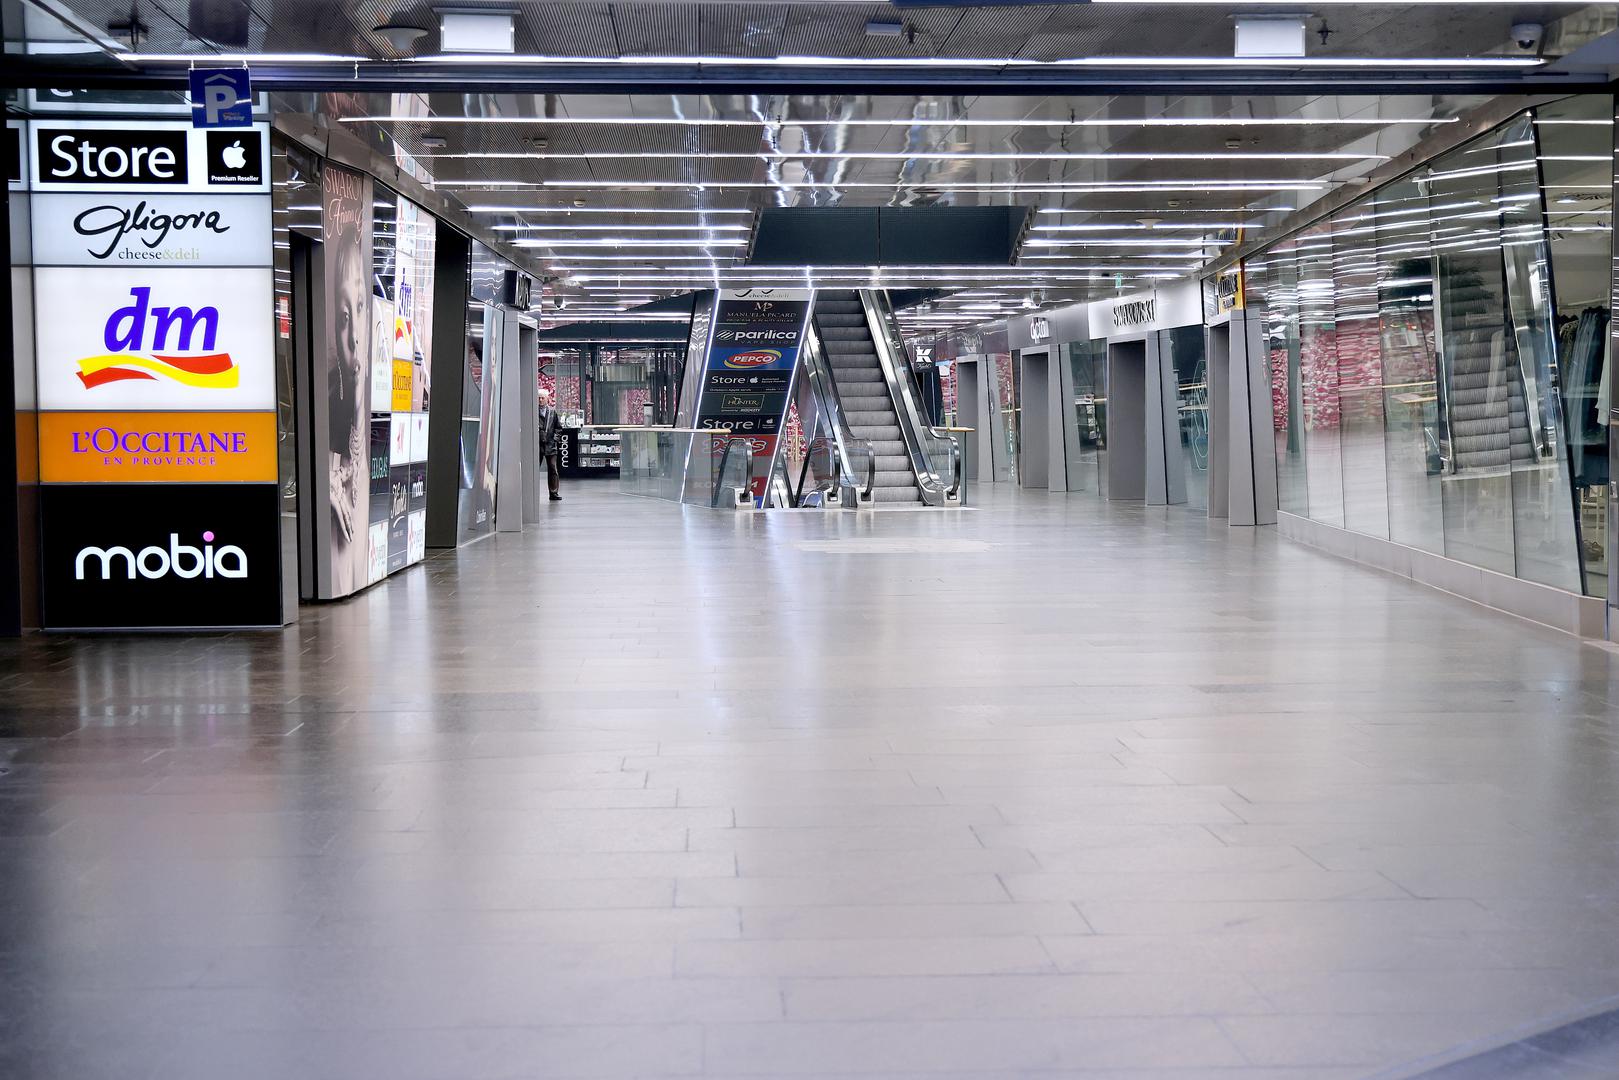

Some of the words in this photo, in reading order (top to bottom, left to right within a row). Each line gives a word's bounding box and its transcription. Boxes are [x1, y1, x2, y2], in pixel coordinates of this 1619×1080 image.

[51, 135, 176, 178] Store
[118, 248, 200, 260] cheese&deli
[104, 286, 219, 352] dm
[735, 330, 797, 341] parilica
[733, 355, 773, 363] PEPCO
[711, 376, 746, 384] Store
[703, 419, 754, 430] Store
[559, 434, 569, 468] mobia
[104, 457, 123, 466] EN
[133, 456, 216, 466] PROVENCE
[75, 530, 248, 579] mobia
